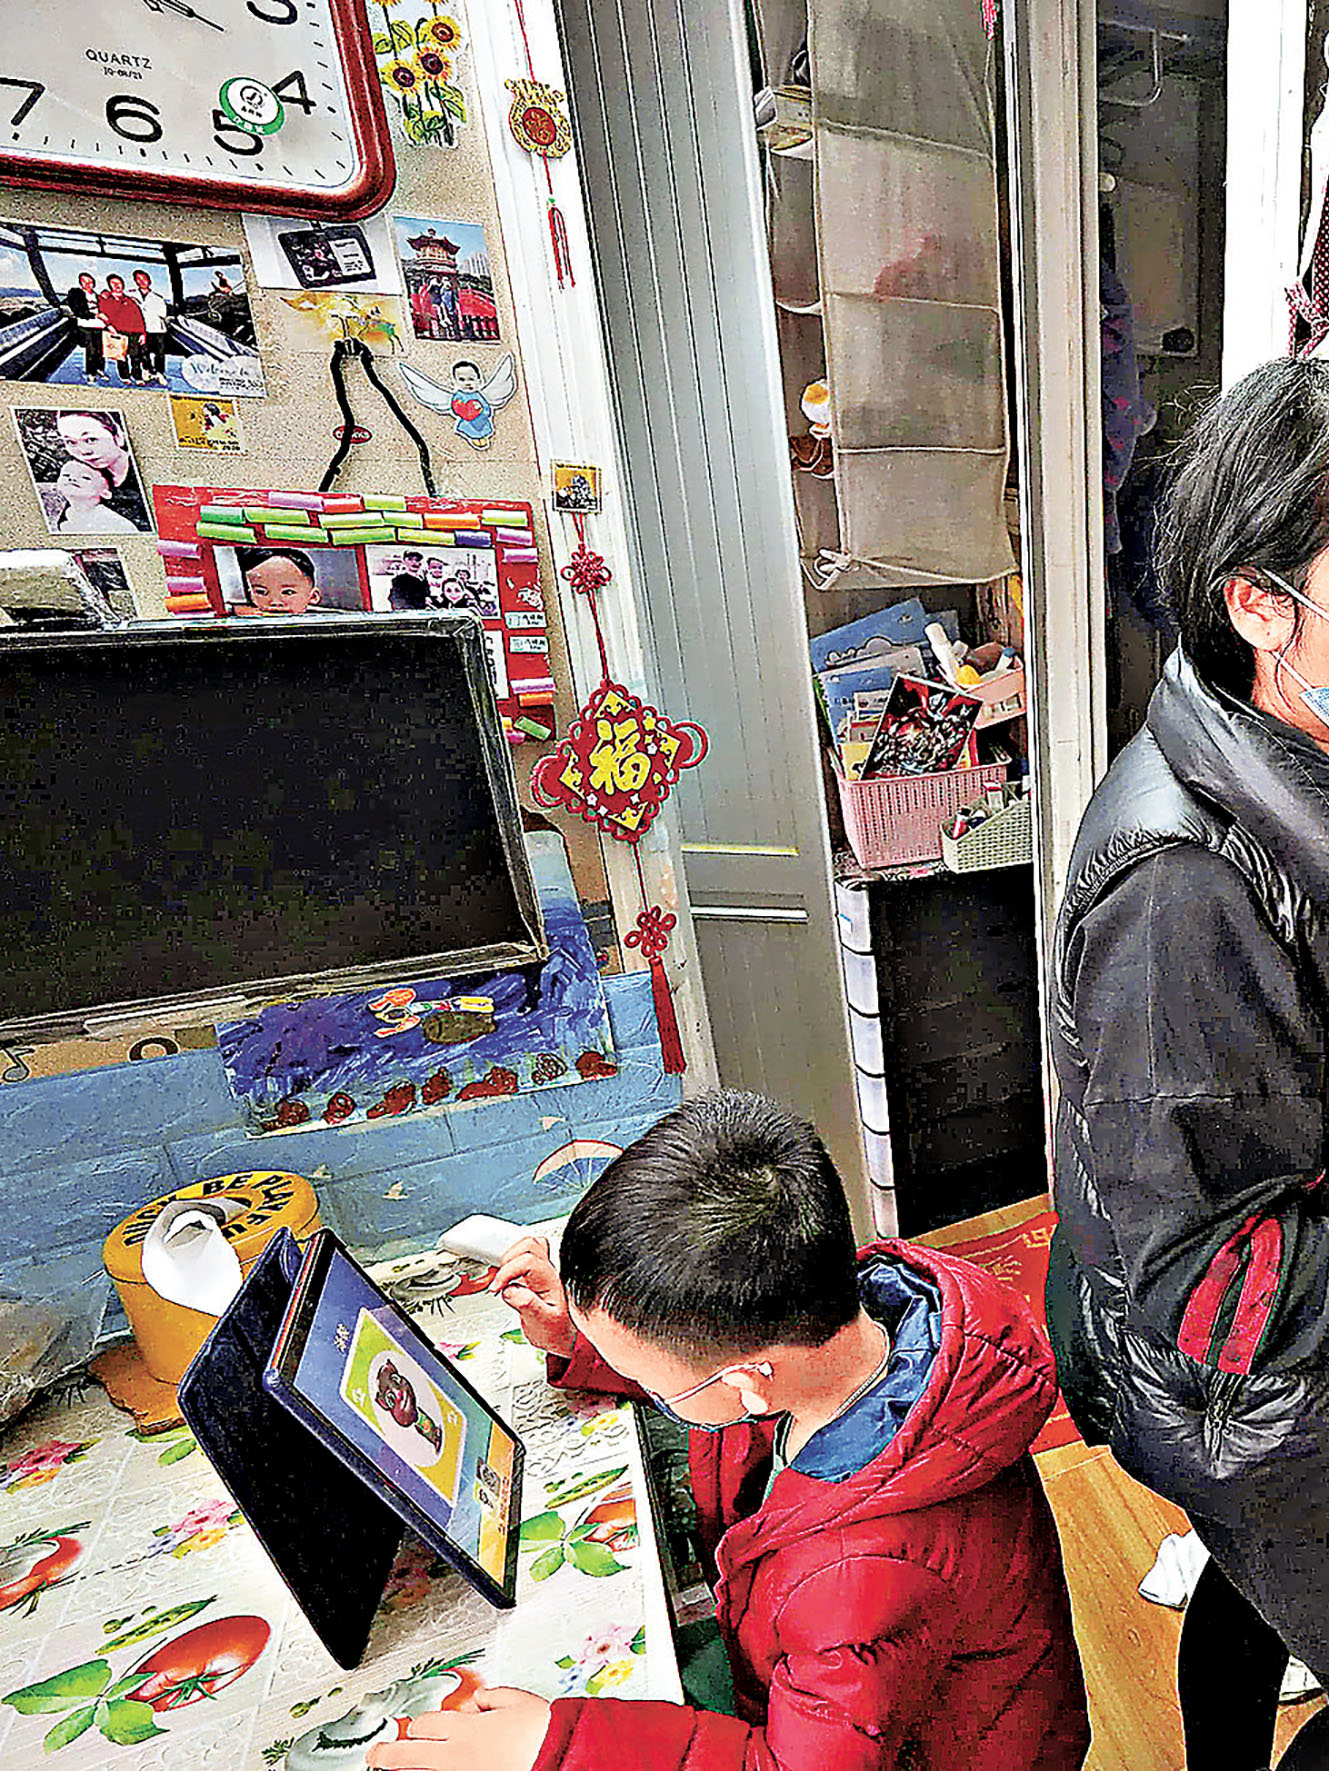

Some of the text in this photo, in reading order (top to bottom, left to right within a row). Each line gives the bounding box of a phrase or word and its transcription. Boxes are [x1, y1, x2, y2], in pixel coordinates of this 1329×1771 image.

[85, 49, 153, 70] QUARTZ
[0, 77, 45, 126] 7
[106, 94, 163, 143] 6
[589, 717, 652, 796] 福
